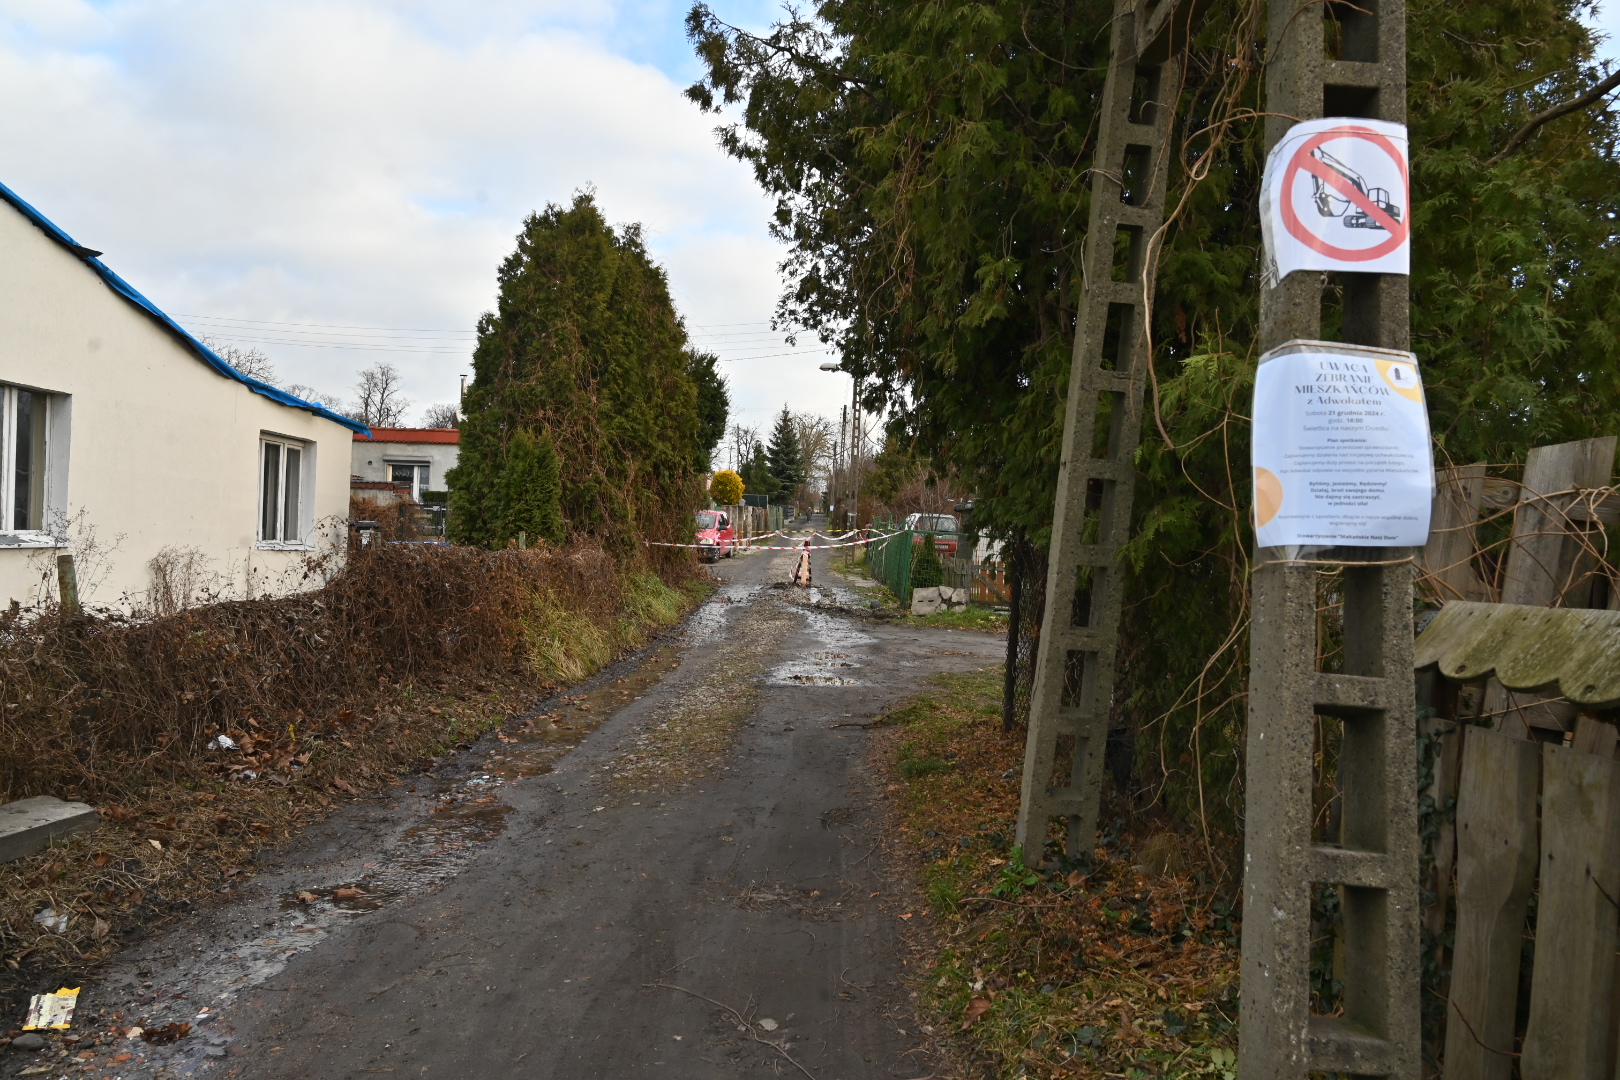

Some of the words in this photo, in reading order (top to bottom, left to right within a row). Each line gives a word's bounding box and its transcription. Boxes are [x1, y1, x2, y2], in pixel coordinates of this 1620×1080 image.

[1320, 362, 1368, 373] UWAGA
[1316, 373, 1373, 384] ZEBRANIE
[1296, 383, 1389, 396] MIESZKAŃCÓW
[1317, 396, 1381, 406] Adwokatem
